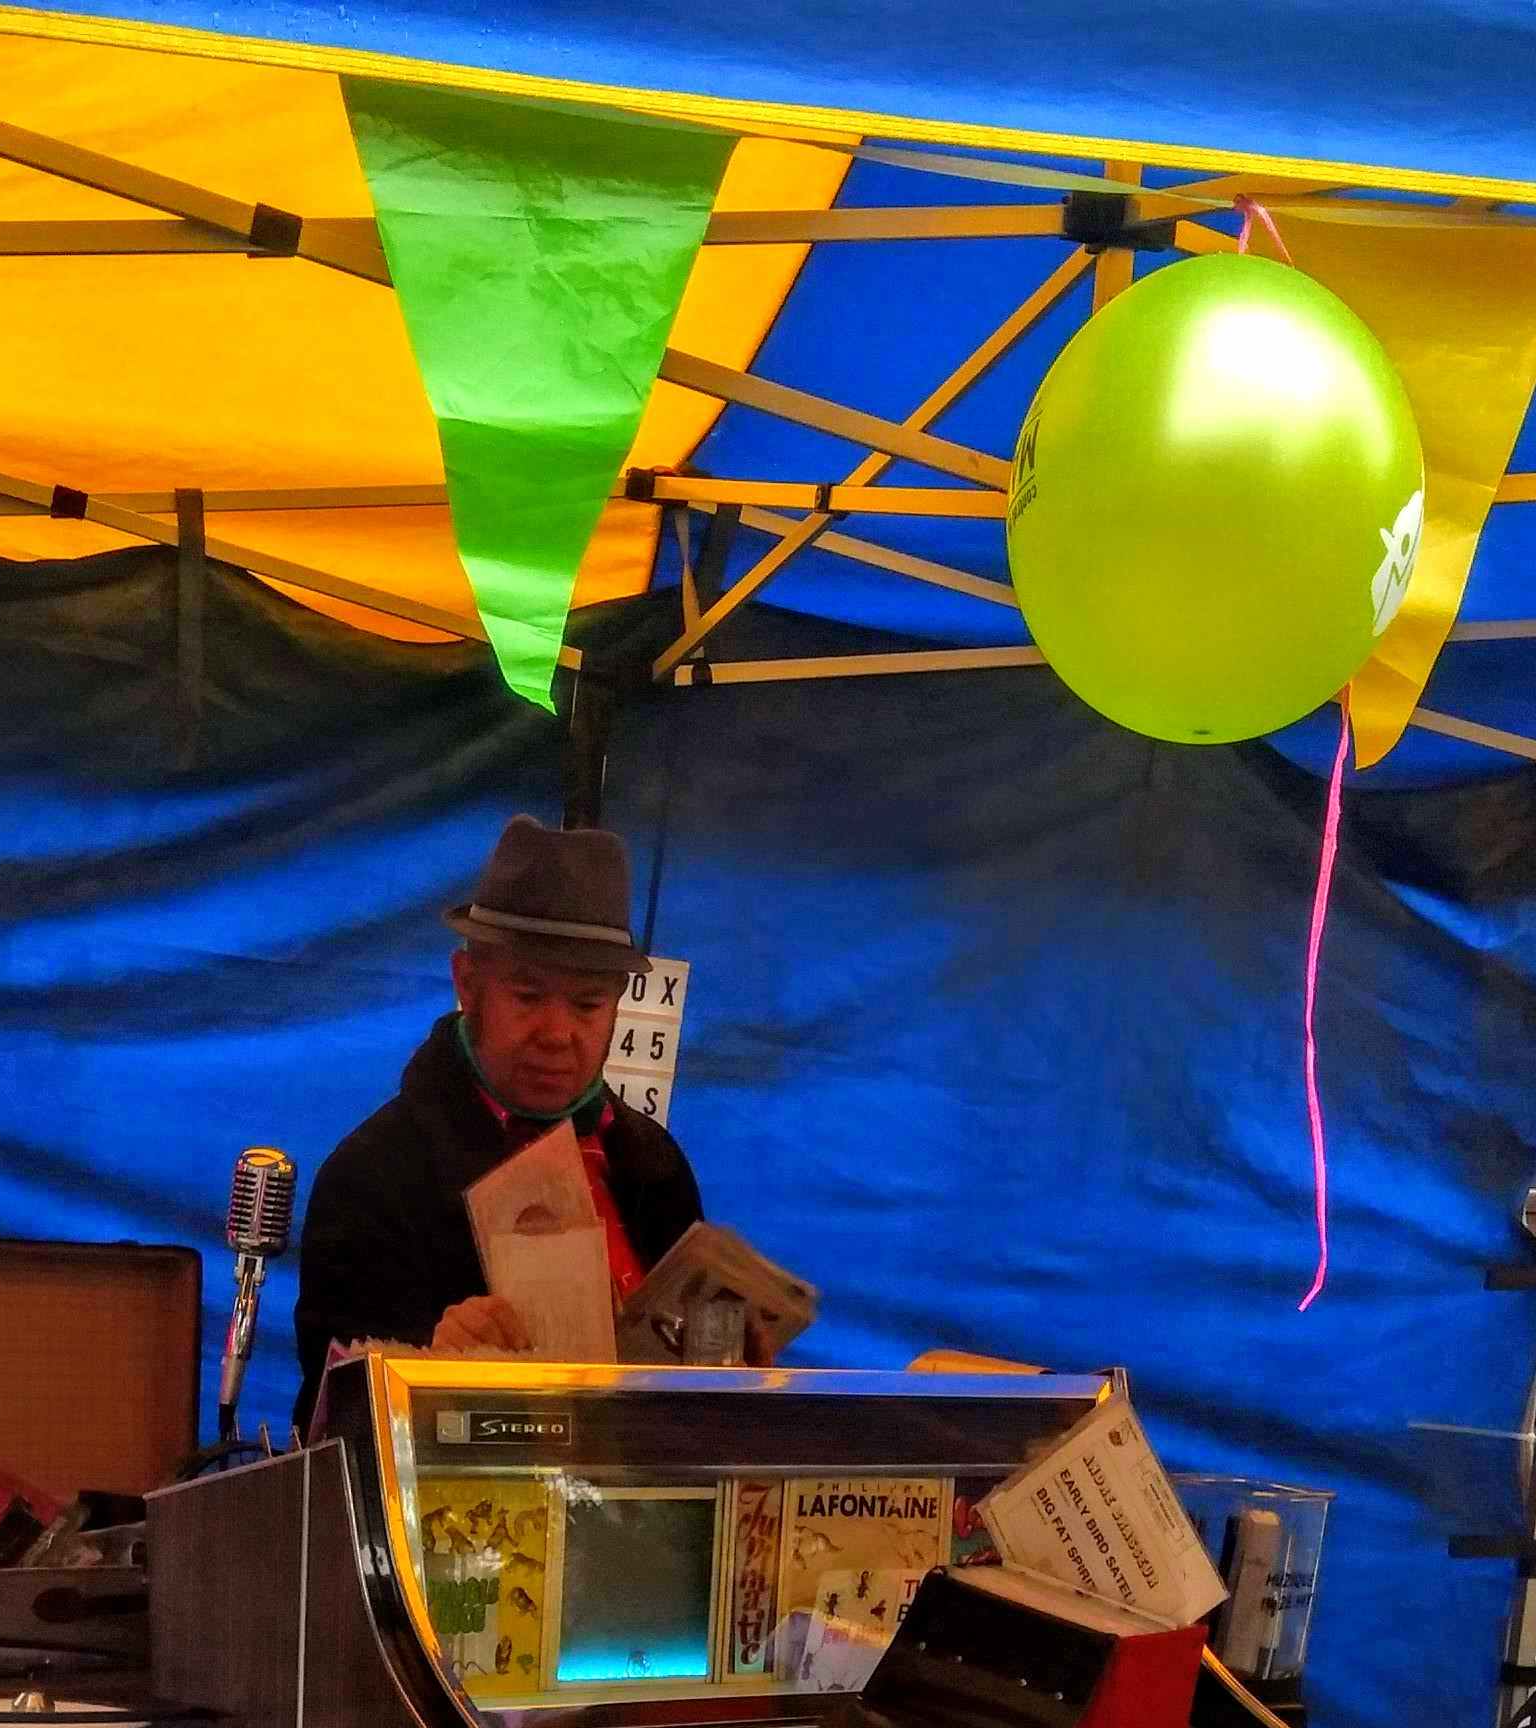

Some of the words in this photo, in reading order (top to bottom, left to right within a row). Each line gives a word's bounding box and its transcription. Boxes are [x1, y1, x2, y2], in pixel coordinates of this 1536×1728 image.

[796, 1493, 939, 1520] LAFONTAINE
[1035, 1487, 1057, 1516] BIG
[1051, 1515, 1072, 1545] FAT
[1059, 1468, 1089, 1517] EARLY
[1084, 1517, 1111, 1555] BIRD
